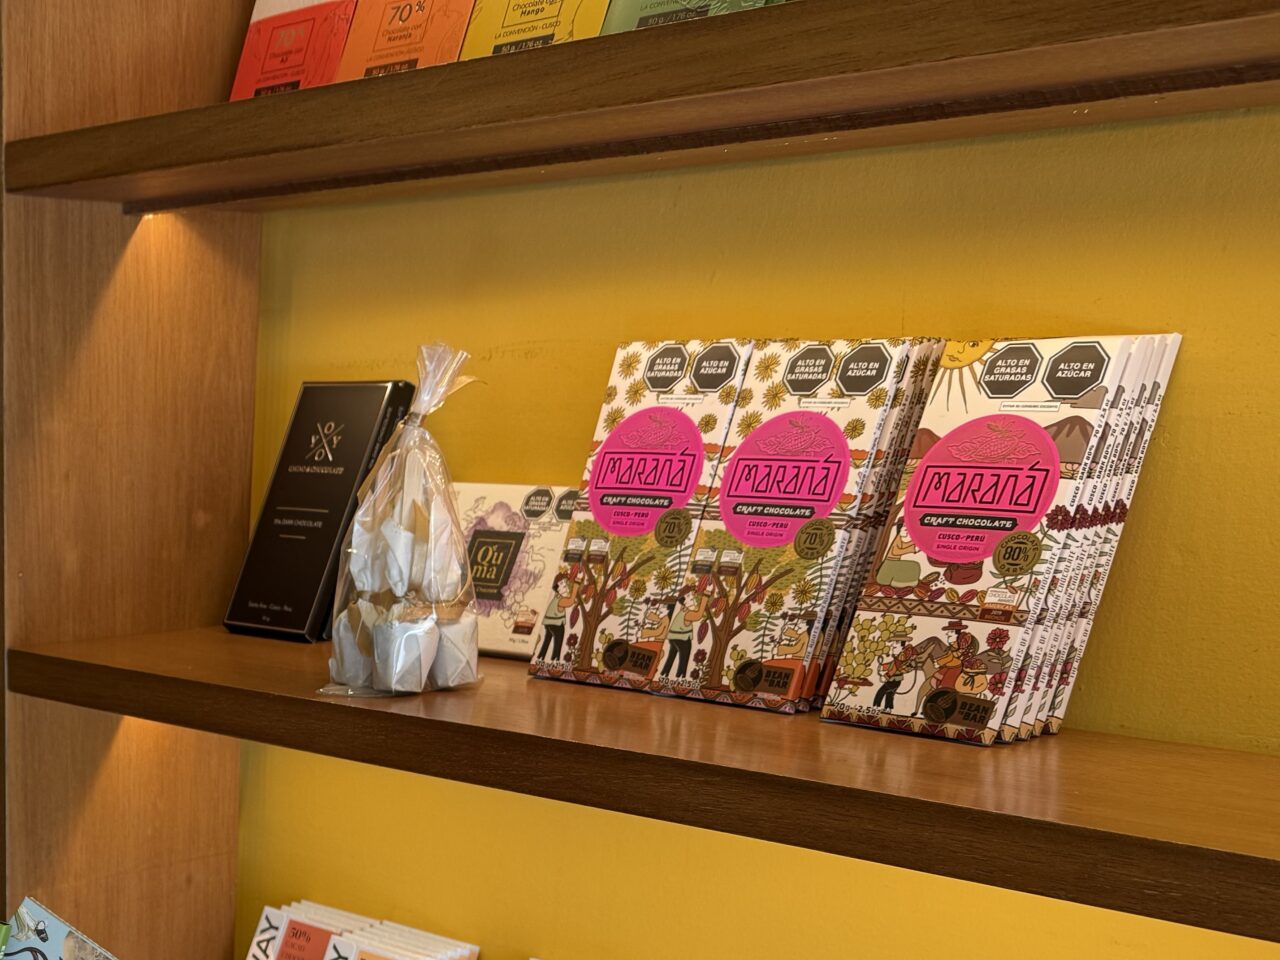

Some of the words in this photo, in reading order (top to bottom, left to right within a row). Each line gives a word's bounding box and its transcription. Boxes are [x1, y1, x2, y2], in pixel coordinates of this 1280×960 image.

[520, 7, 544, 17] Mango
[700, 366, 726, 374] AZÚCAR
[847, 368, 877, 376] AZÚCAR
[1056, 369, 1092, 377] AZÚCAR
[984, 373, 1032, 381] SATURADAS
[1069, 485, 1080, 508] CUSCO
[627, 498, 669, 506] CHOCOLATE
[736, 505, 762, 513] CRAFT
[764, 507, 812, 516] CHOCOLATE
[924, 516, 954, 525] CRAFT
[956, 518, 1013, 528] CHOCOLATE
[1000, 564, 1025, 574] DARK
[959, 702, 983, 714] BEAN
[963, 712, 986, 725] BAR
[289, 927, 311, 943] 50%
